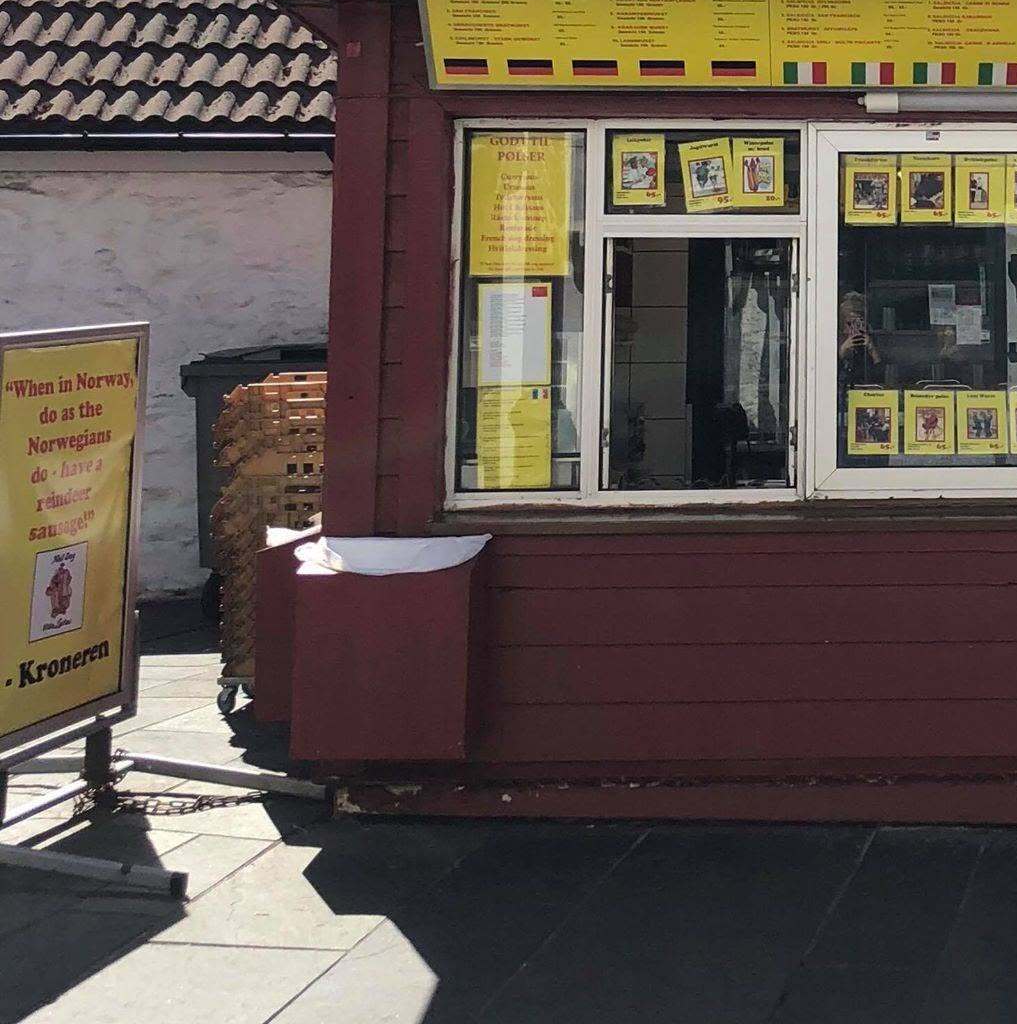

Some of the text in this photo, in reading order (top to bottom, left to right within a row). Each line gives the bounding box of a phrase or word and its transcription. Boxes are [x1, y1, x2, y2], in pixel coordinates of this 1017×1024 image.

[58, 376, 73, 393] in
[39, 401, 103, 424] do as the
[27, 429, 112, 455] Norwegians
[30, 466, 48, 484] do
[61, 459, 93, 478] have
[95, 458, 103, 471] a
[36, 488, 92, 512] reindeer
[18, 640, 109, 688] Kroneren
